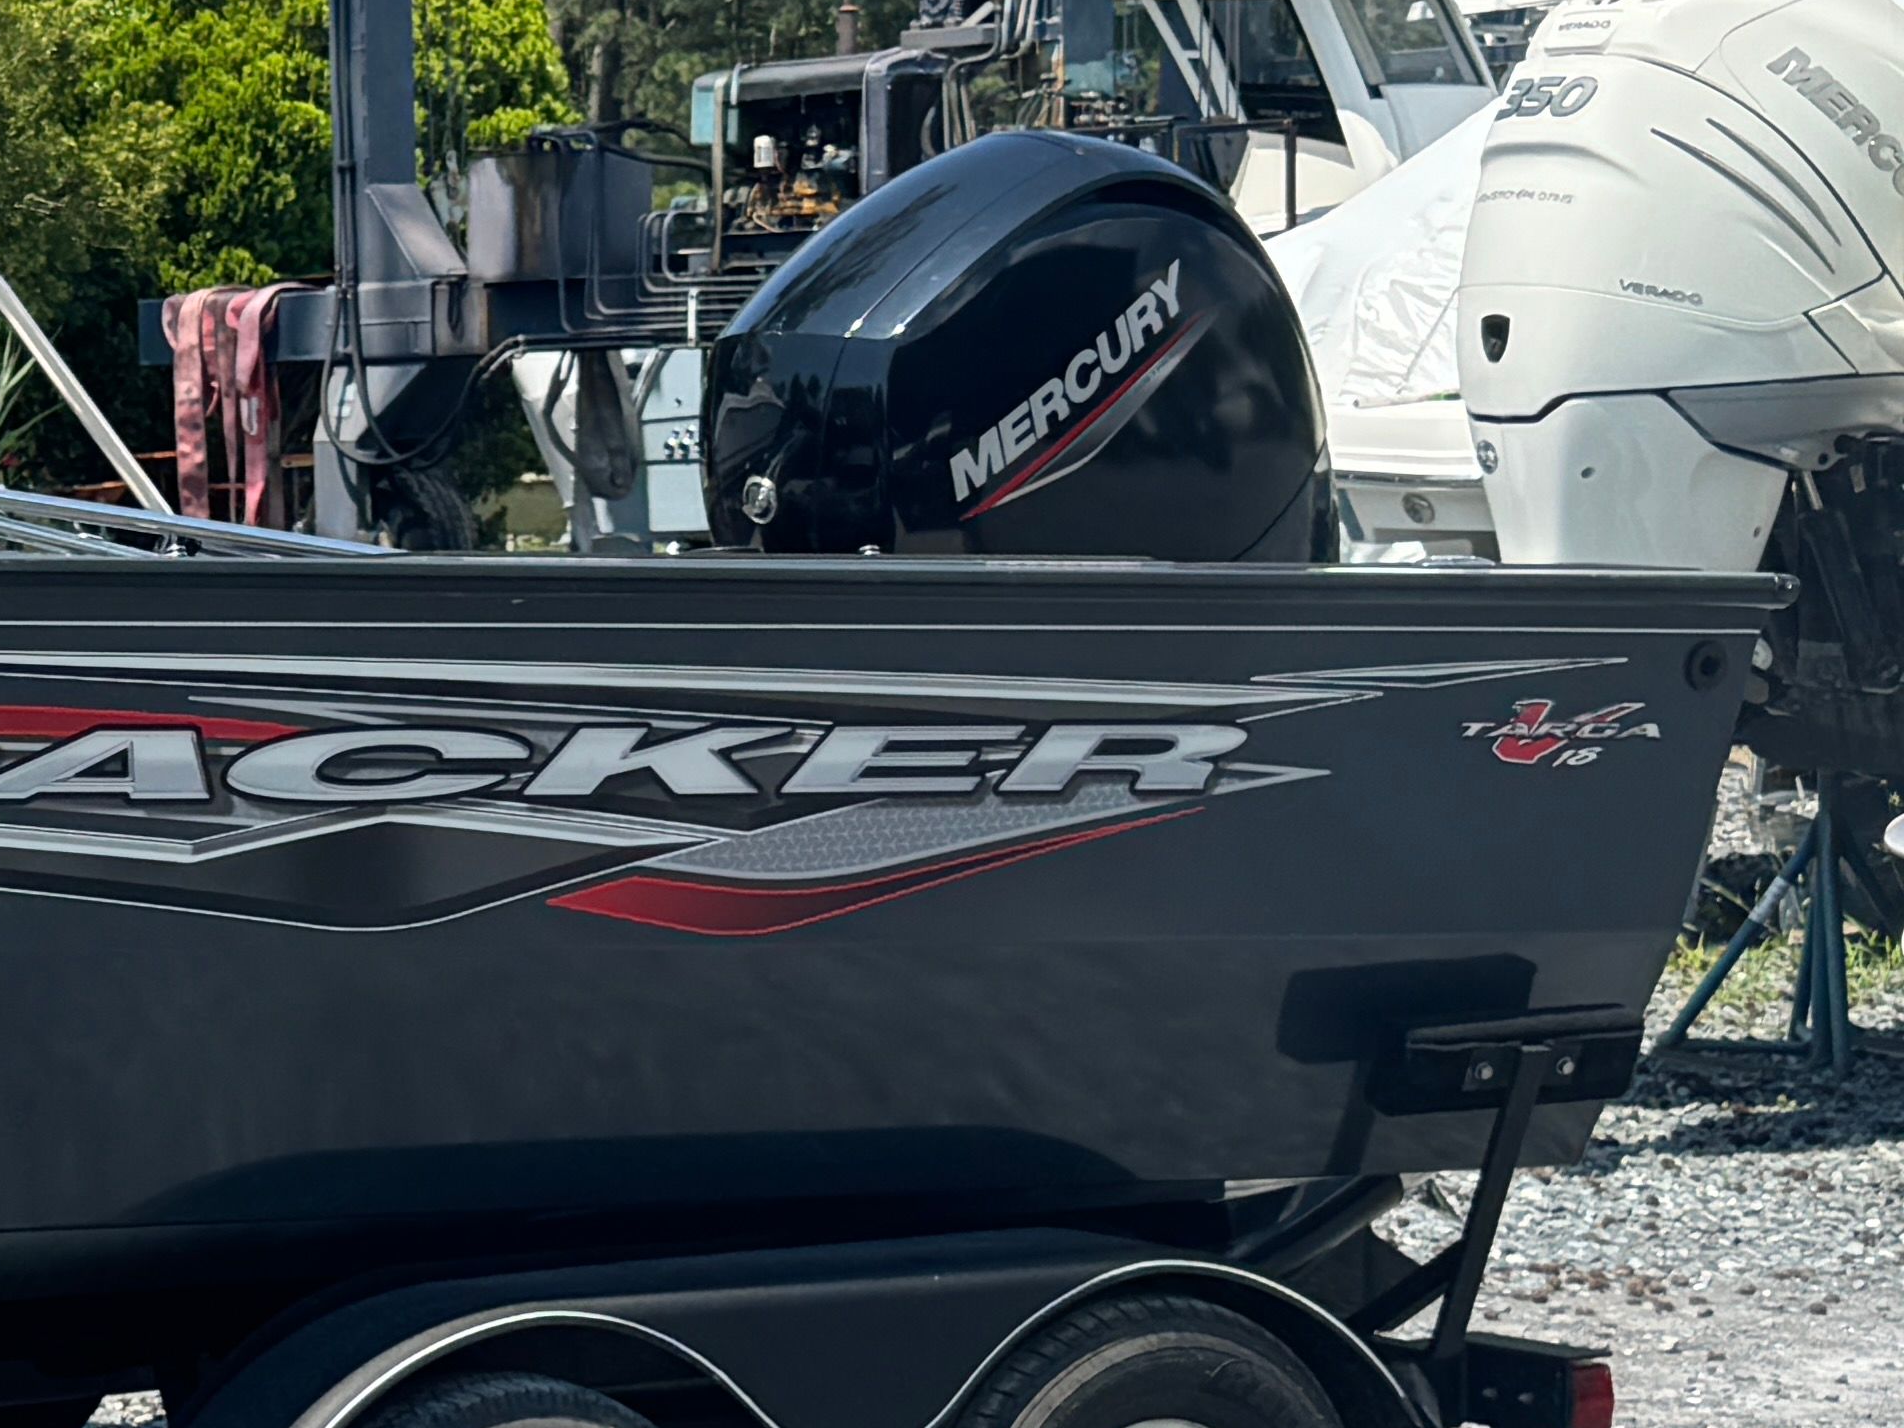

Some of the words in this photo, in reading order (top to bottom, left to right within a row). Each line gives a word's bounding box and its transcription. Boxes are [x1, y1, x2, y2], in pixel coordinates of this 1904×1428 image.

[1494, 75, 1599, 122] 350
[1619, 278, 1703, 305] VERADO
[949, 258, 1181, 503] MERCURY
[1461, 722, 1662, 739] TARGA
[1551, 747, 1605, 768] 18
